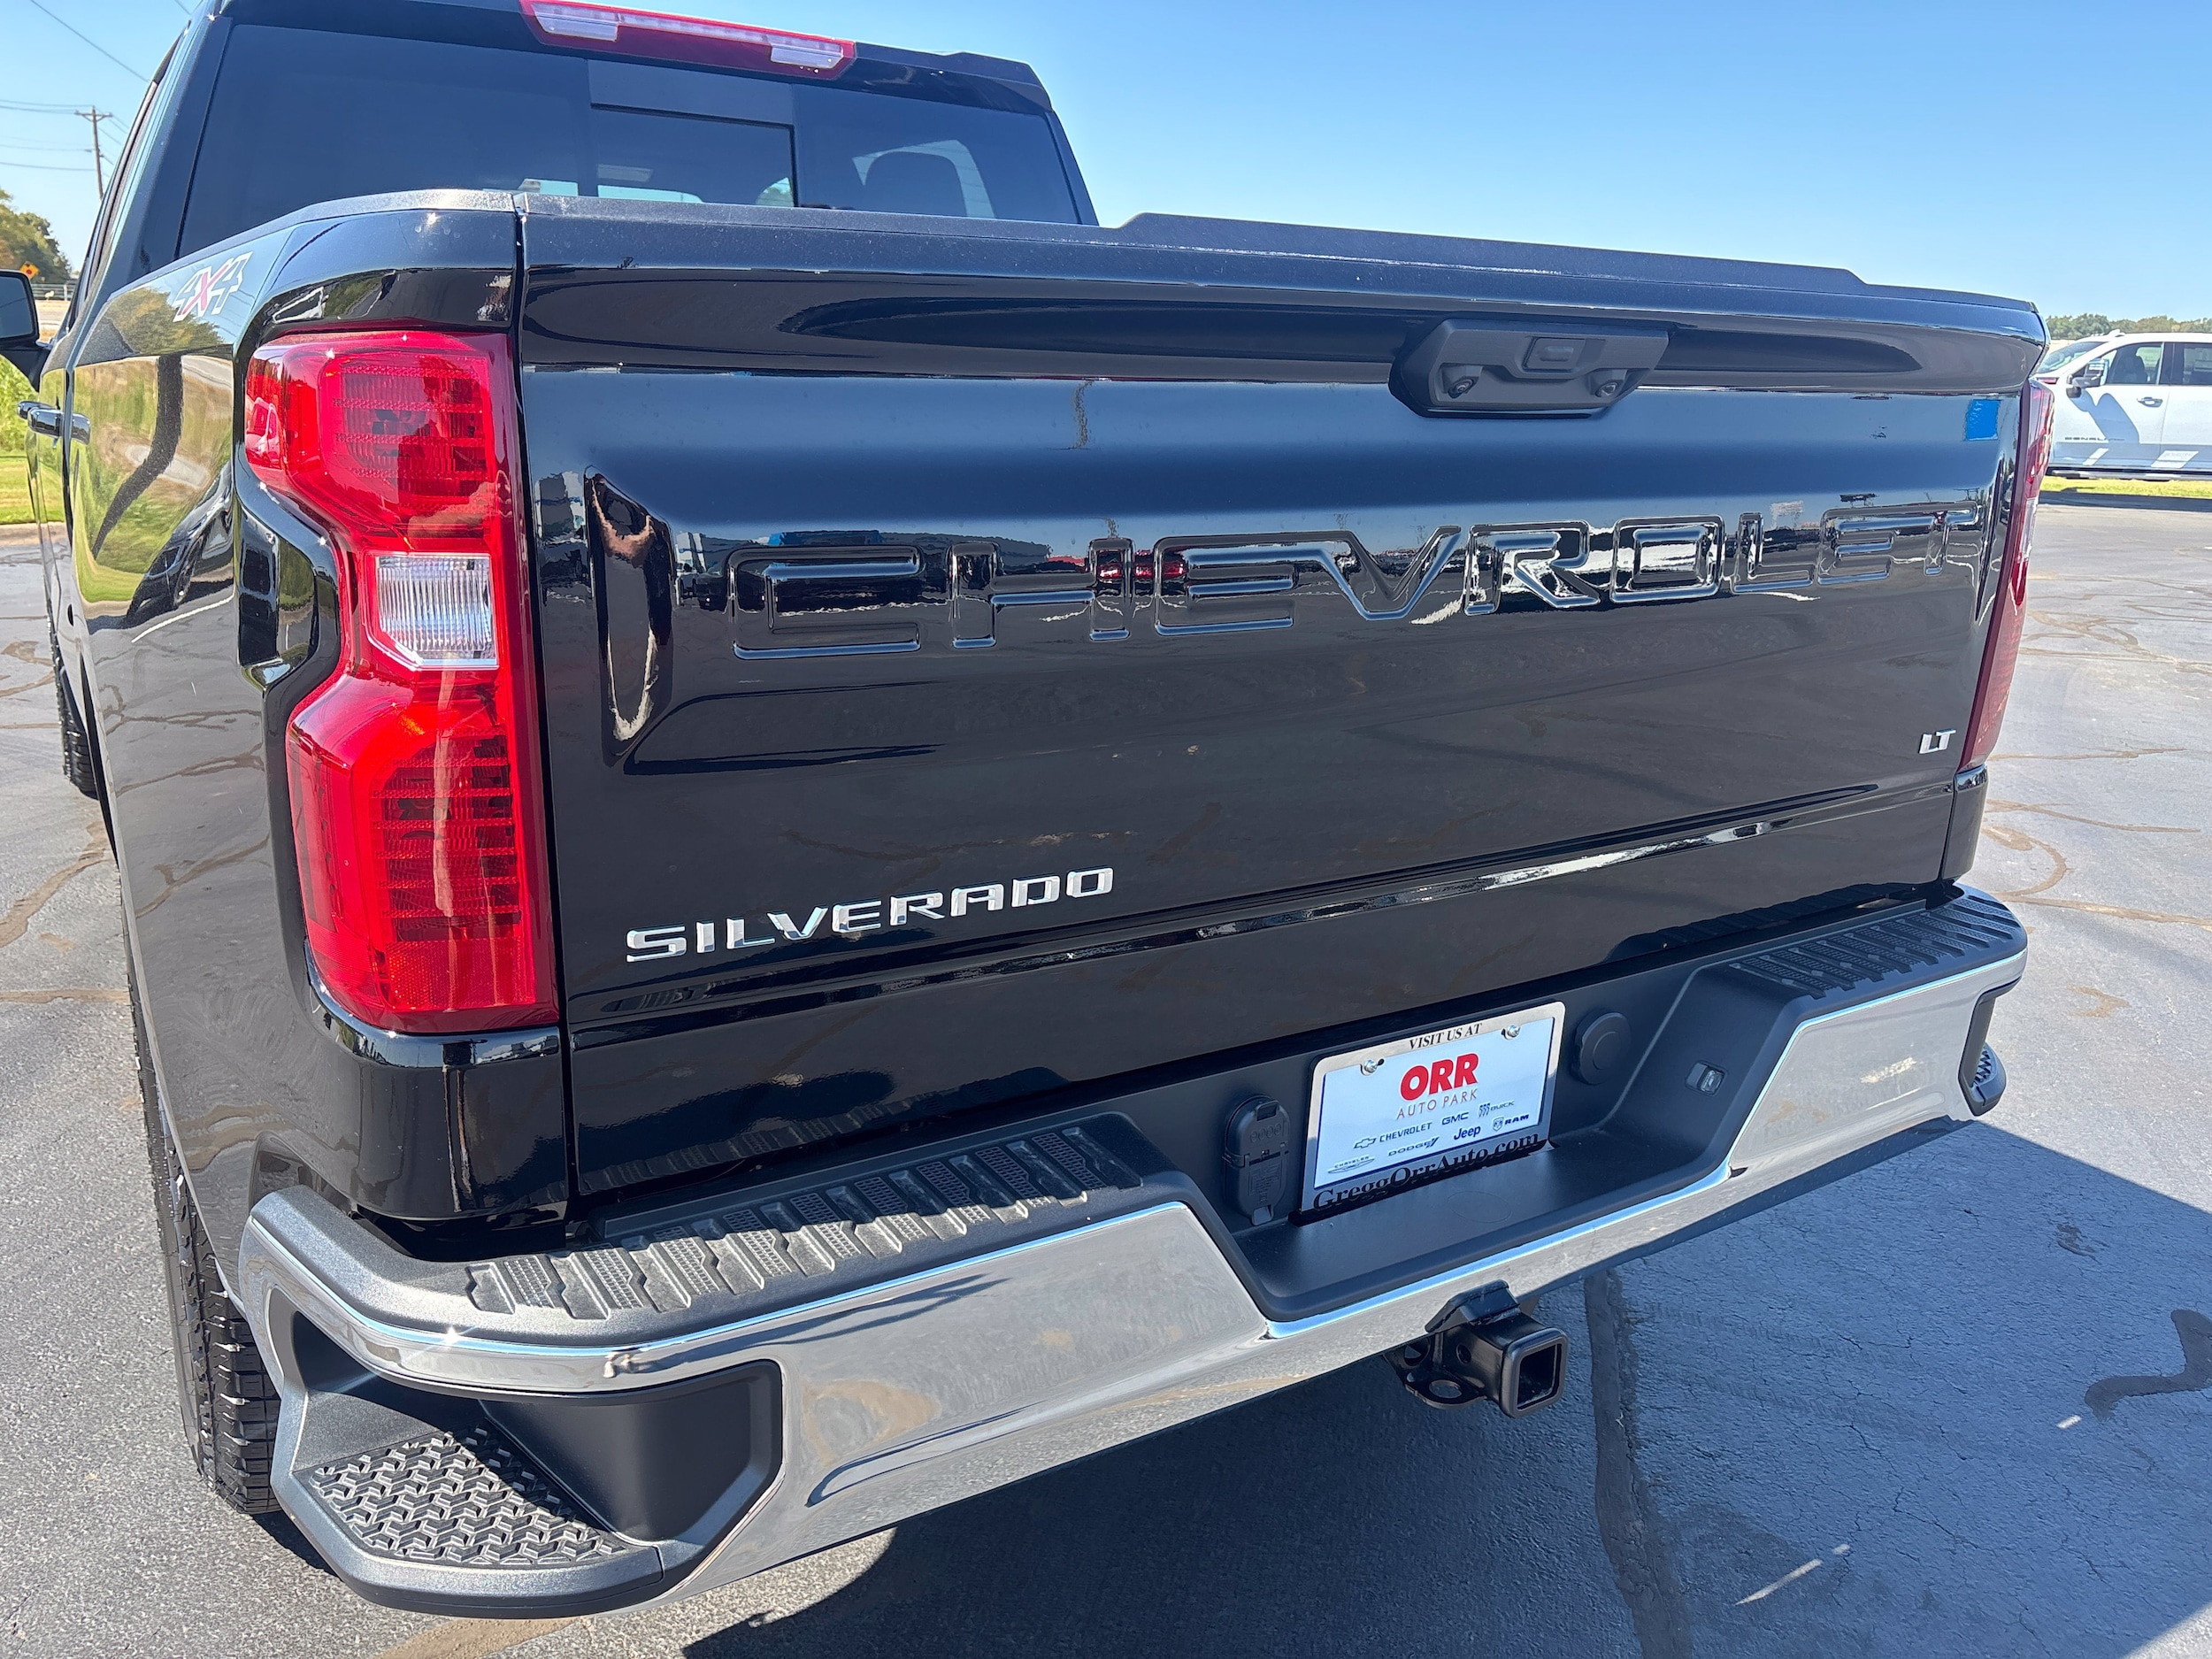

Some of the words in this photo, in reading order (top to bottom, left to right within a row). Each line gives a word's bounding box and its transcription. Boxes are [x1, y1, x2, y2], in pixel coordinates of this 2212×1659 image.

[727, 501, 1980, 660] CHEVROLET
[1918, 728, 1956, 755] LT
[625, 867, 1115, 963] SILVERADO
[1409, 1032, 1447, 1050] VISIT
[1447, 1028, 1463, 1041] US
[1463, 1023, 1483, 1037] AT
[1400, 1053, 1479, 1101] ORR
[1395, 1099, 1436, 1120] AUTO
[1441, 1088, 1478, 1110] PARK
[1490, 1100, 1515, 1111] BUICK
[1379, 1122, 1432, 1143] CHEVROLET
[1441, 1112, 1470, 1125] GMC
[1454, 1125, 1481, 1141] Jeep
[1504, 1114, 1529, 1125] RAM
[1388, 1141, 1431, 1156] DODGE
[1313, 1133, 1540, 1210] GreggOrrAuto.com
